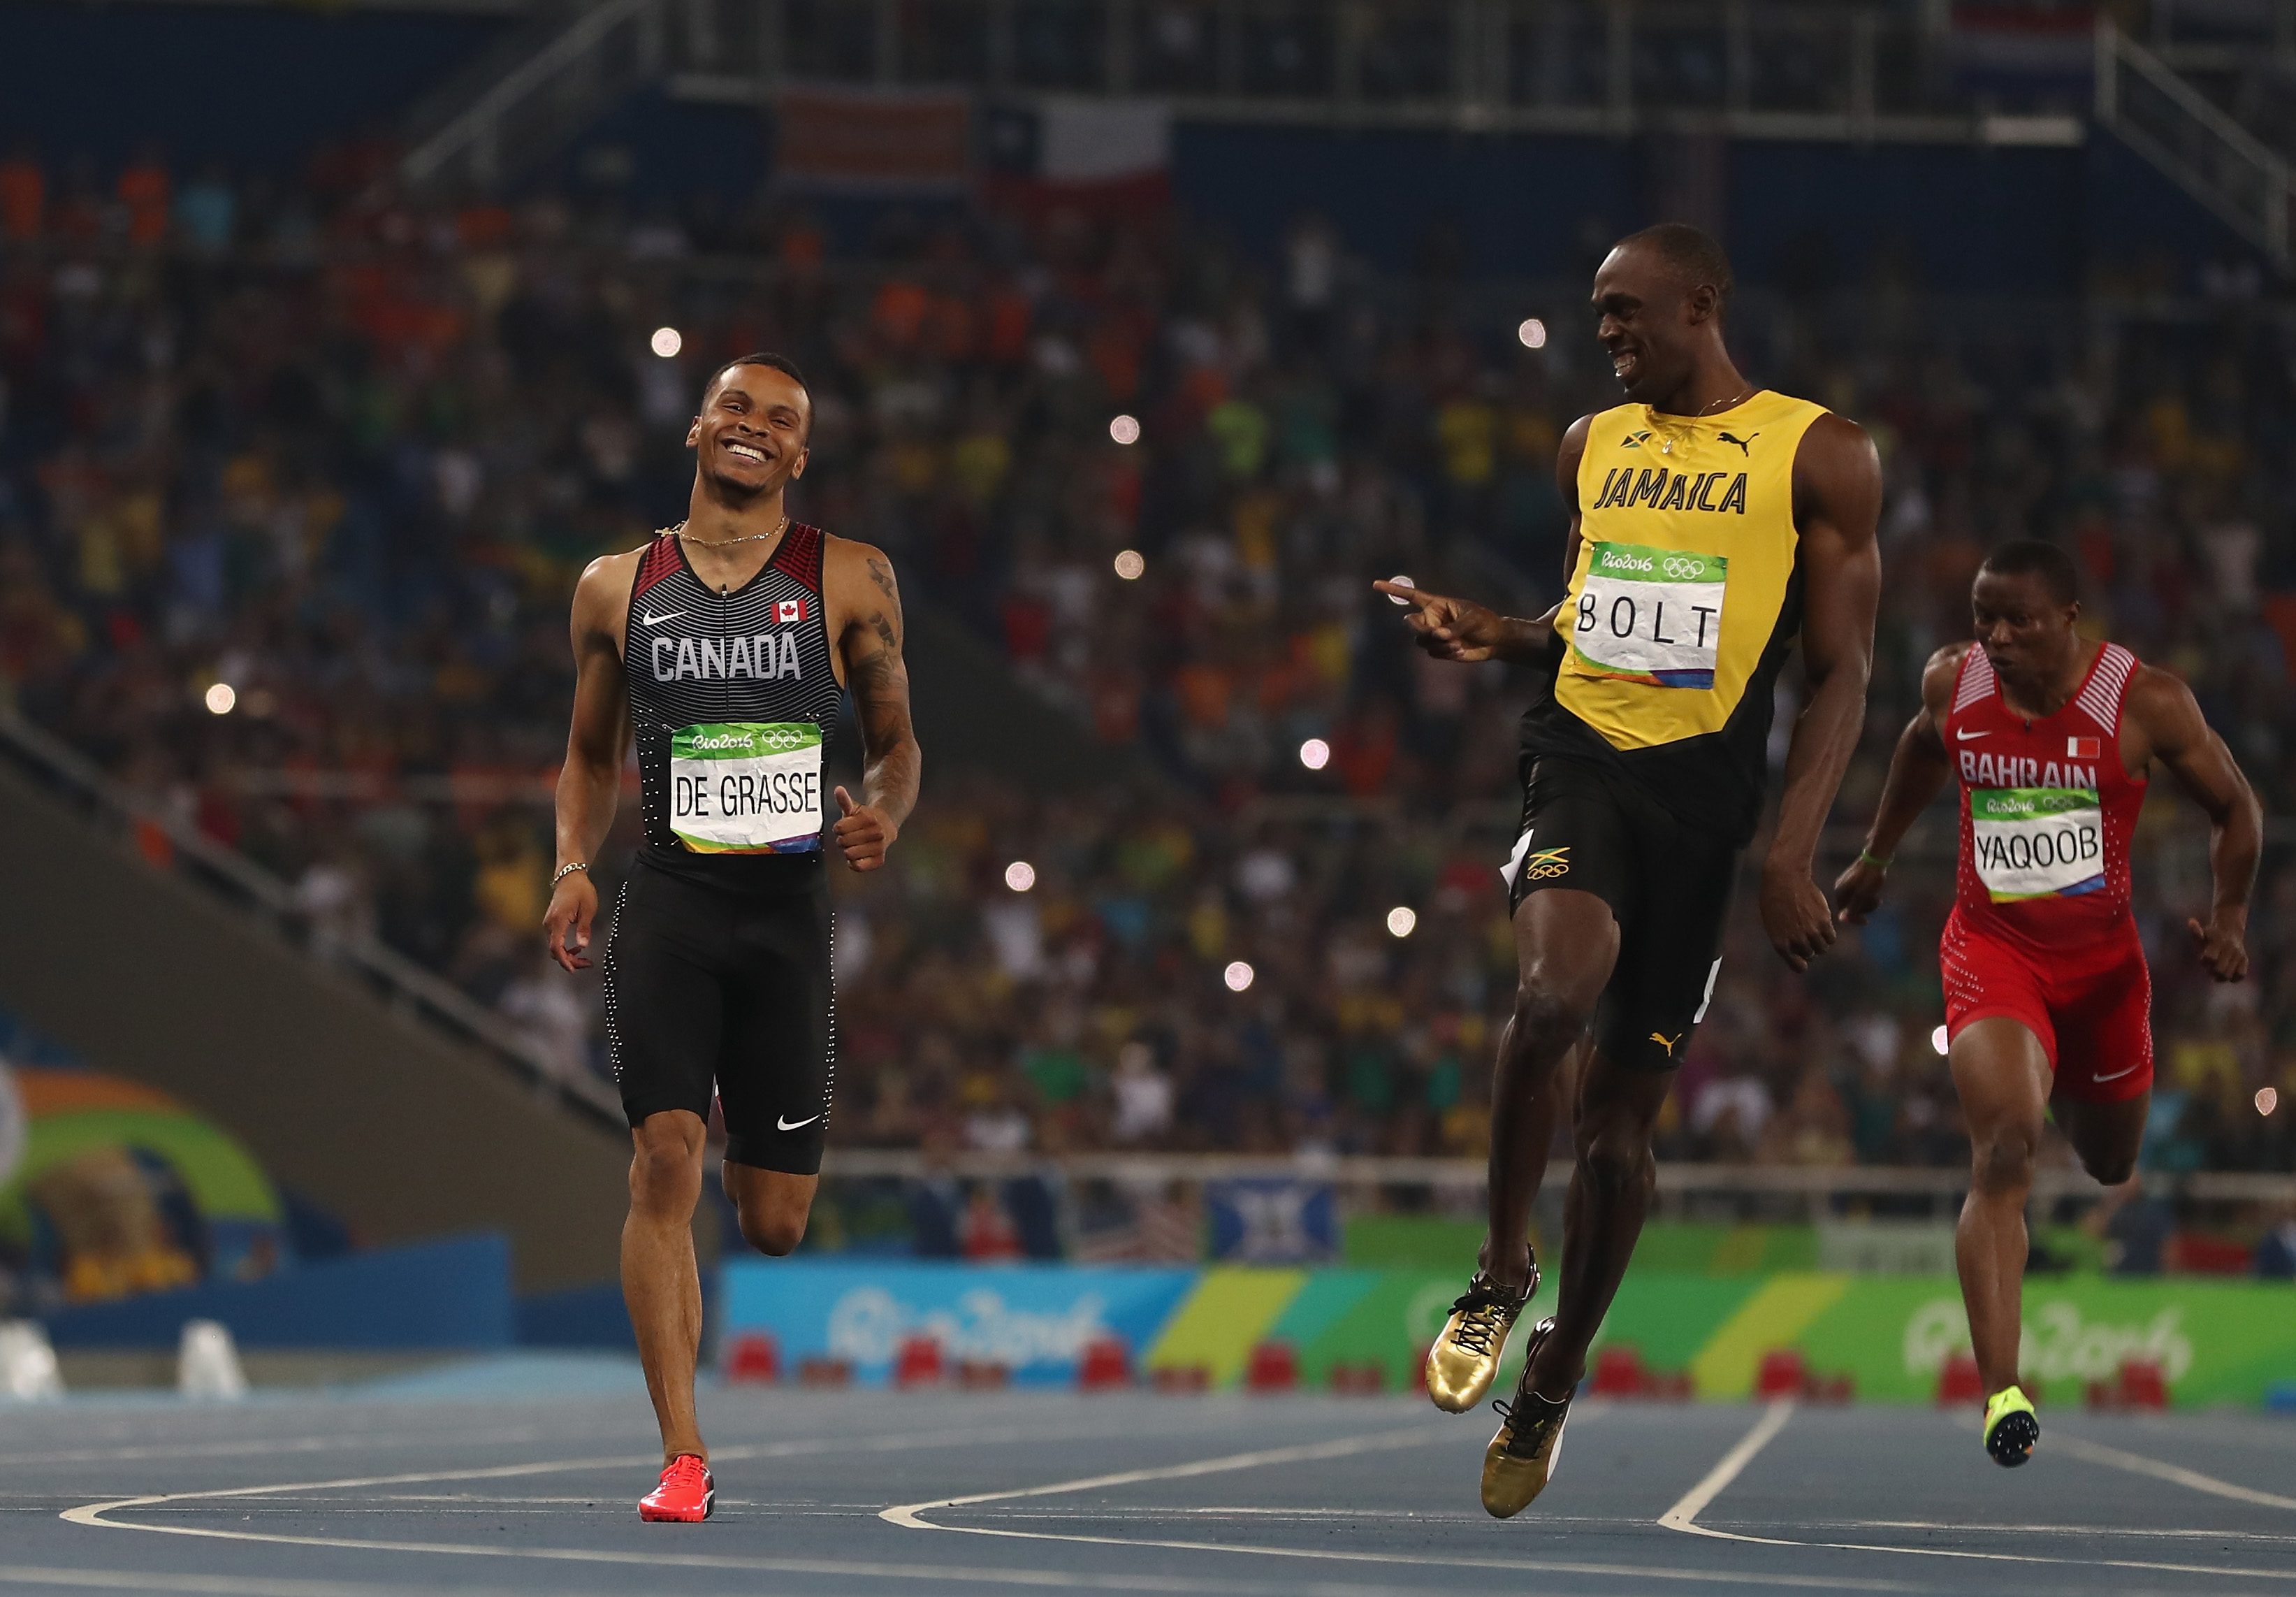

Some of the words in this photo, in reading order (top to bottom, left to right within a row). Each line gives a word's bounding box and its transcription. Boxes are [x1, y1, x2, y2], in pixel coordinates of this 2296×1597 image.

[1594, 468, 1748, 514] JAMAICA
[1577, 593, 1717, 648] BOLT
[651, 632, 802, 681] CANADA
[1959, 749, 2097, 790] BAHRAIN
[676, 775, 709, 817] DE
[720, 772, 818, 816] GRASSE
[1977, 826, 2098, 870] YAQOOB
